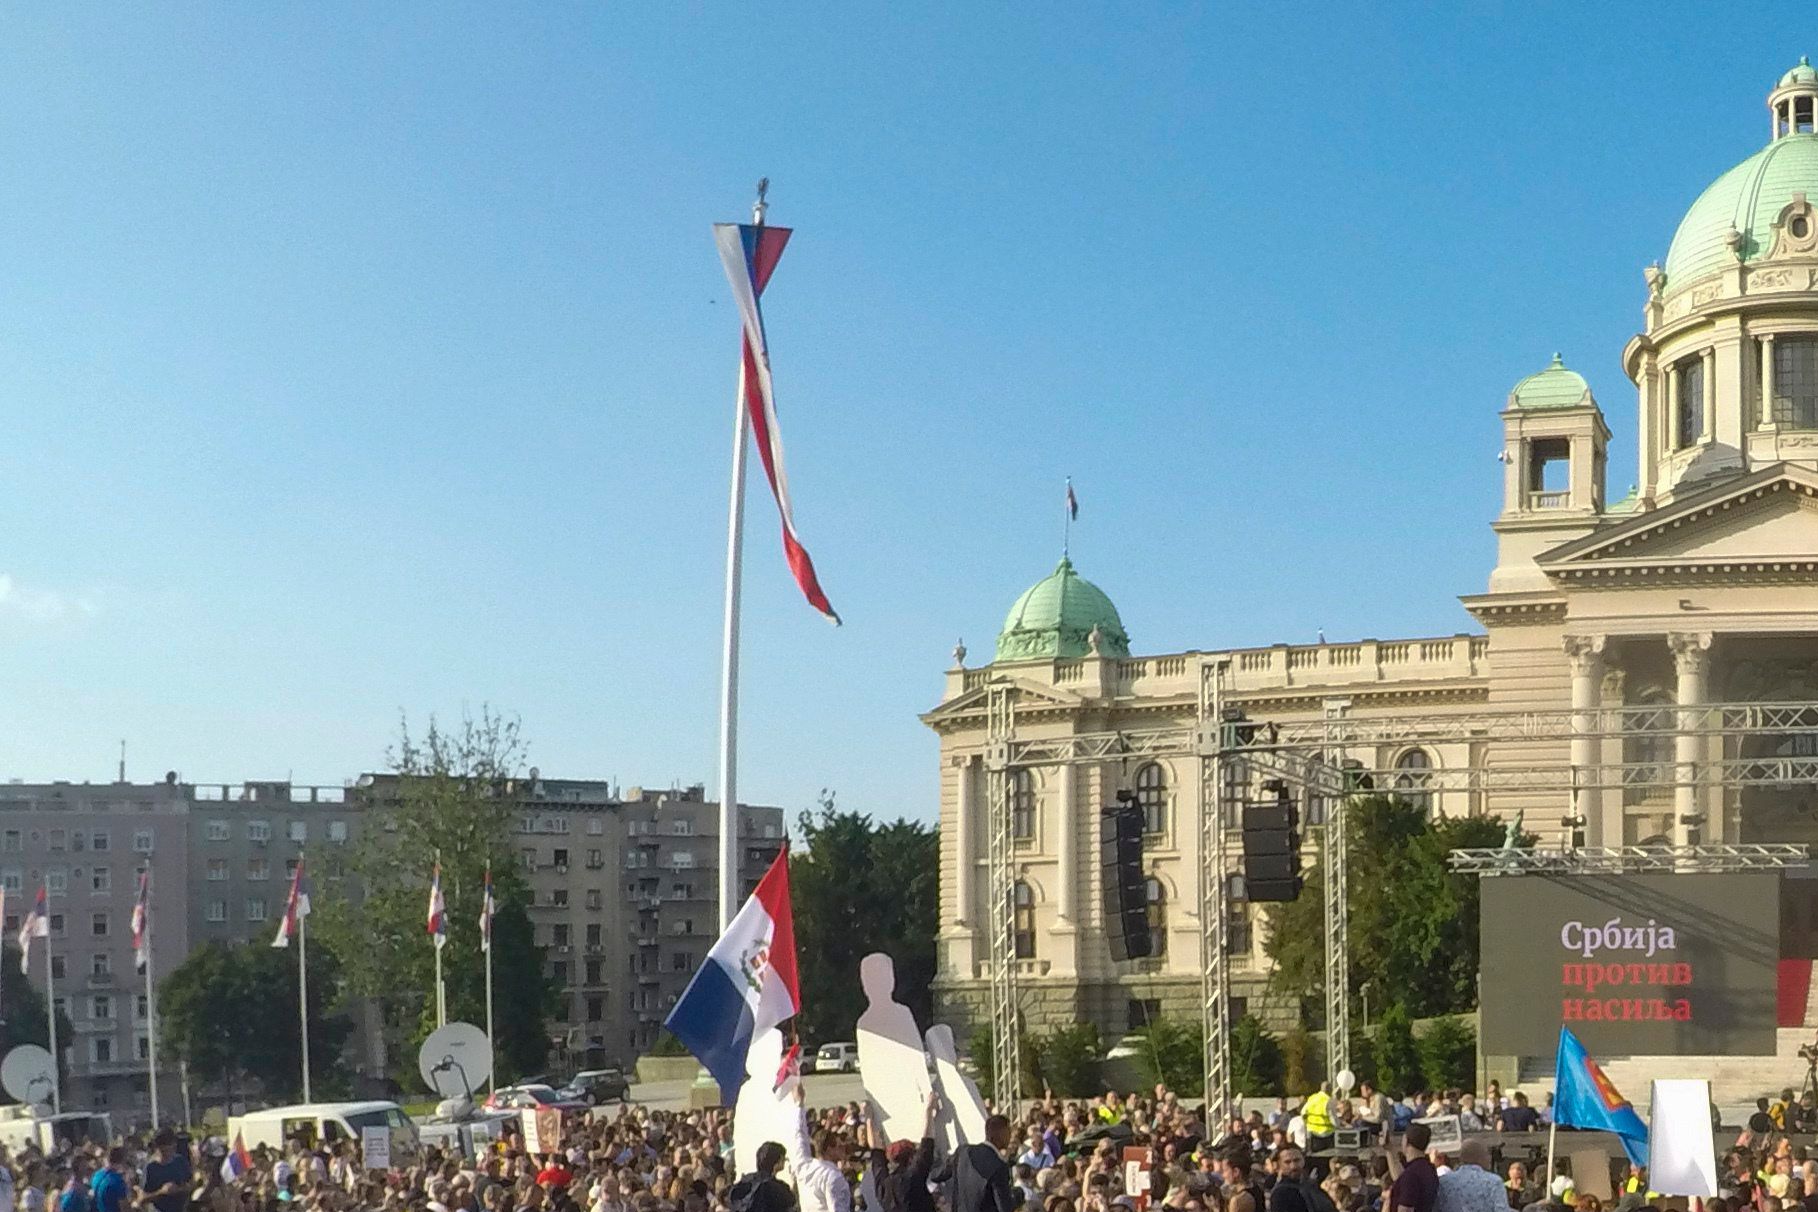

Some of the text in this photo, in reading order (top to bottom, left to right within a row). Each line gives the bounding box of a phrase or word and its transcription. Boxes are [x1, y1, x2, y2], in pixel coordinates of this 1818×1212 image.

[1561, 917, 1676, 957] Србија
[1562, 962, 1693, 992] против
[1562, 998, 1692, 1021] насиља
